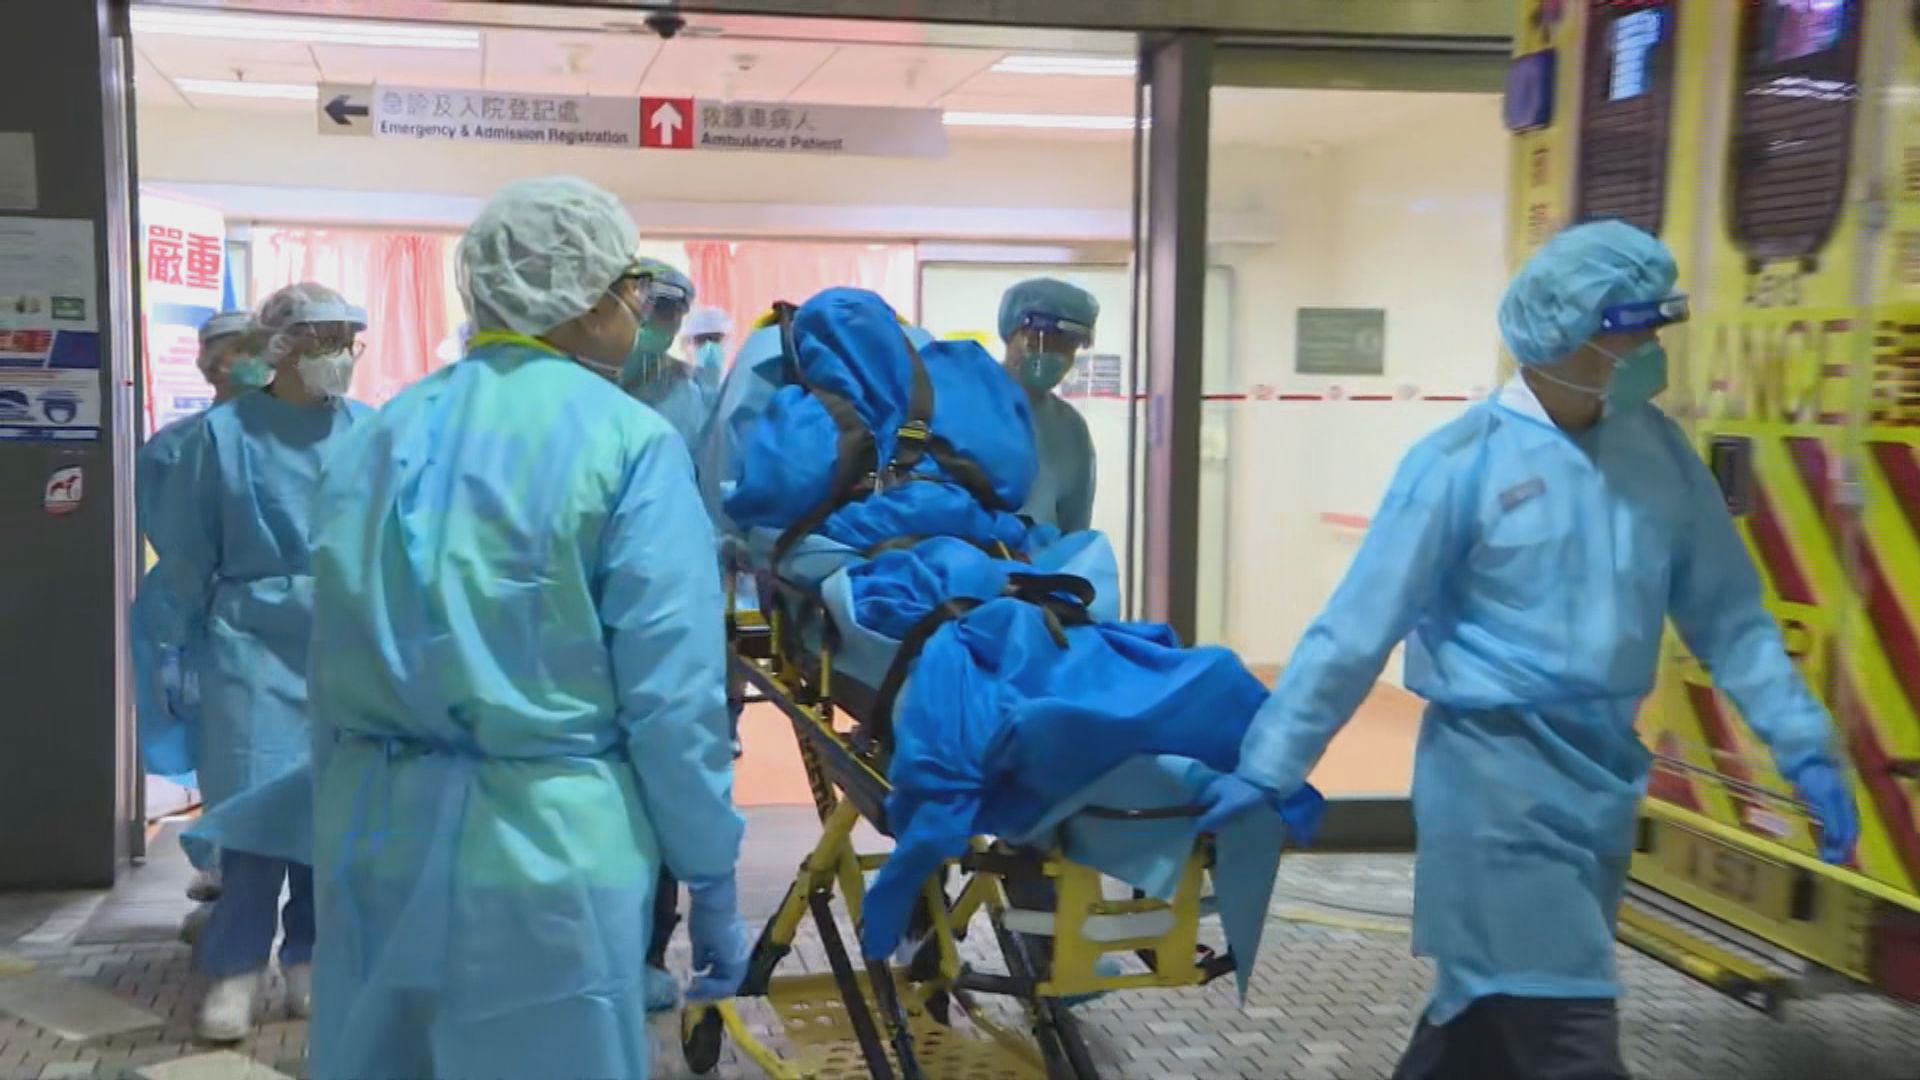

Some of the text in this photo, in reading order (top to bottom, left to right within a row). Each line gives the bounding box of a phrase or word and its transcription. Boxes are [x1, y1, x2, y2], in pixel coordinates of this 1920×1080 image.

[380, 119, 629, 145] Emergency & Admission Registration
[701, 131, 843, 150] Ambulance Patient
[147, 223, 221, 290] 嚴重
